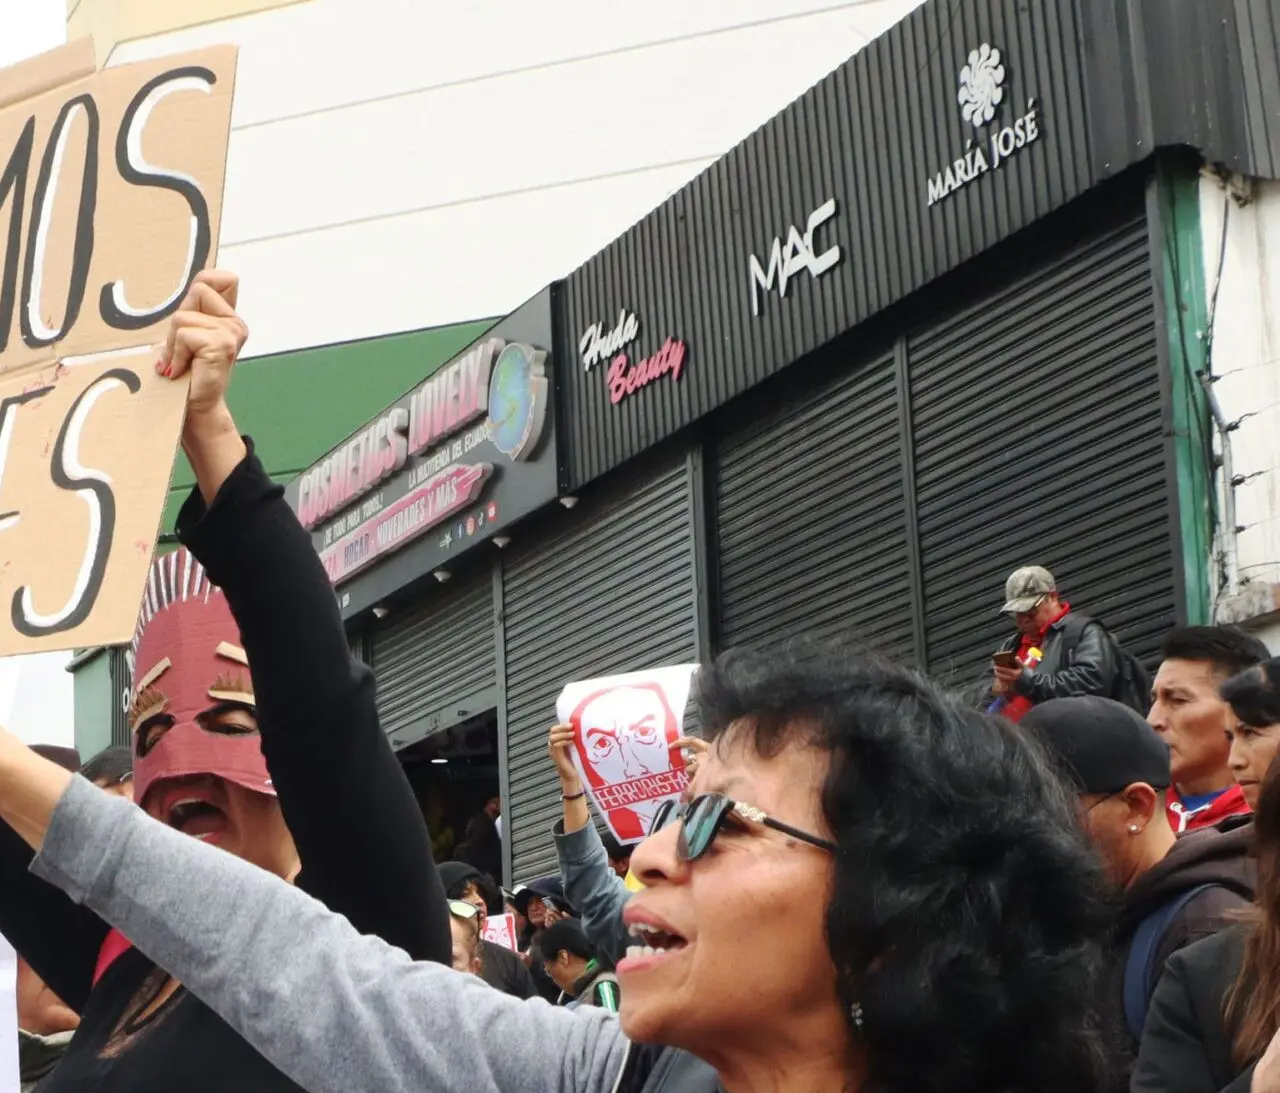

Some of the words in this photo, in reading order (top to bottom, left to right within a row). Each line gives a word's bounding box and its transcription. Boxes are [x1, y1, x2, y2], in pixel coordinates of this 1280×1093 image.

[927, 139, 988, 206] MARÍA
[990, 97, 1039, 168] JOSÉ
[749, 198, 841, 316] MAC
[579, 308, 639, 372] Huda
[607, 335, 685, 404] Beauty
[595, 769, 690, 809] TERRORISTA
